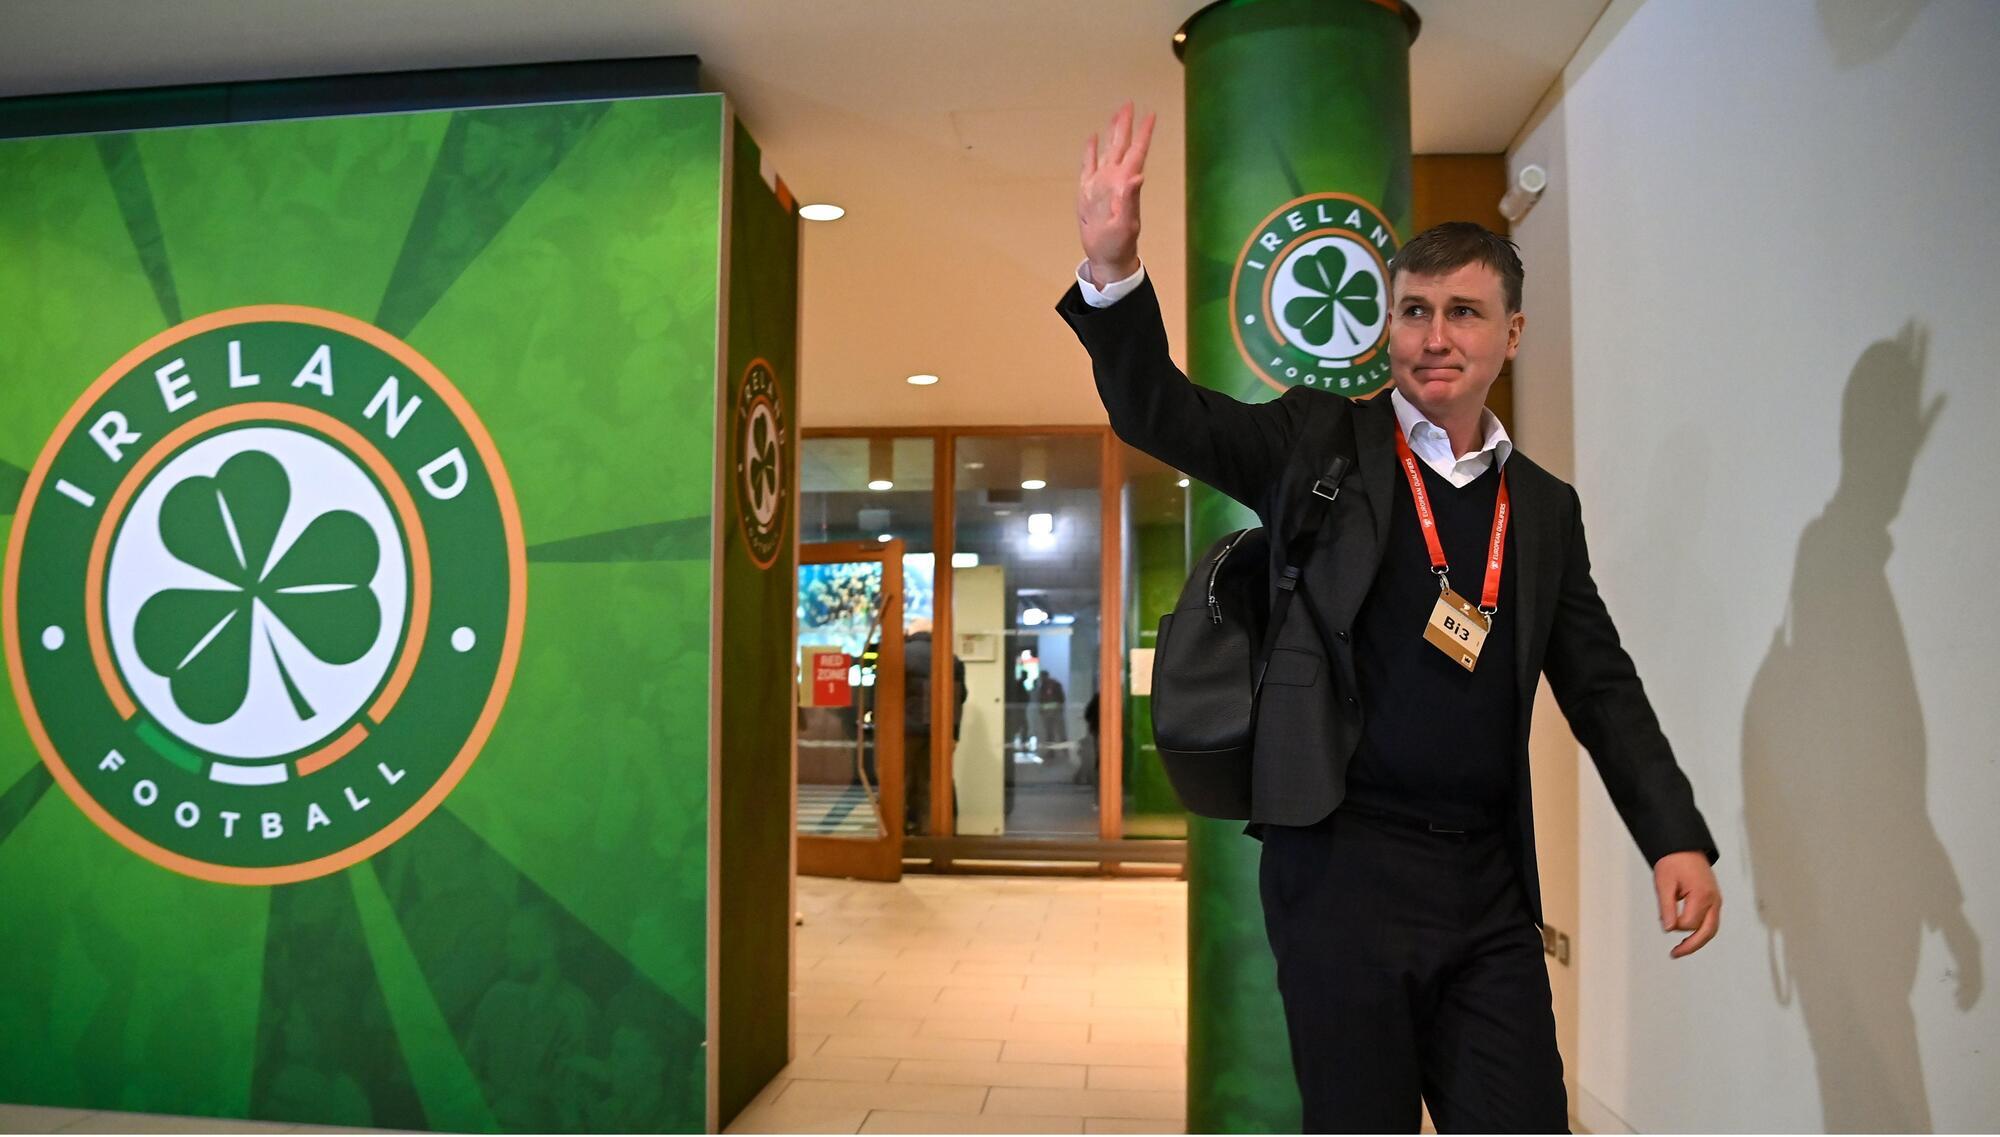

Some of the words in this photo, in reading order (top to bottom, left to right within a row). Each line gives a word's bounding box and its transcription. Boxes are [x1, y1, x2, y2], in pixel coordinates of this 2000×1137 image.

[1246, 203, 1394, 271] IRELAN
[1270, 356, 1391, 389] FOOTBALL
[54, 339, 470, 508] IRELAND
[1406, 457, 1421, 487] QUALIFIERS
[1416, 487, 1429, 518] EUROPEAN
[1496, 503, 1507, 532] QUALIFIERS
[1492, 532, 1501, 561] EUROPEAN
[1443, 615, 1470, 641] Bi3
[816, 668, 847, 681] ZONE
[820, 654, 844, 667] RED
[98, 748, 405, 839] FOOTBALL
